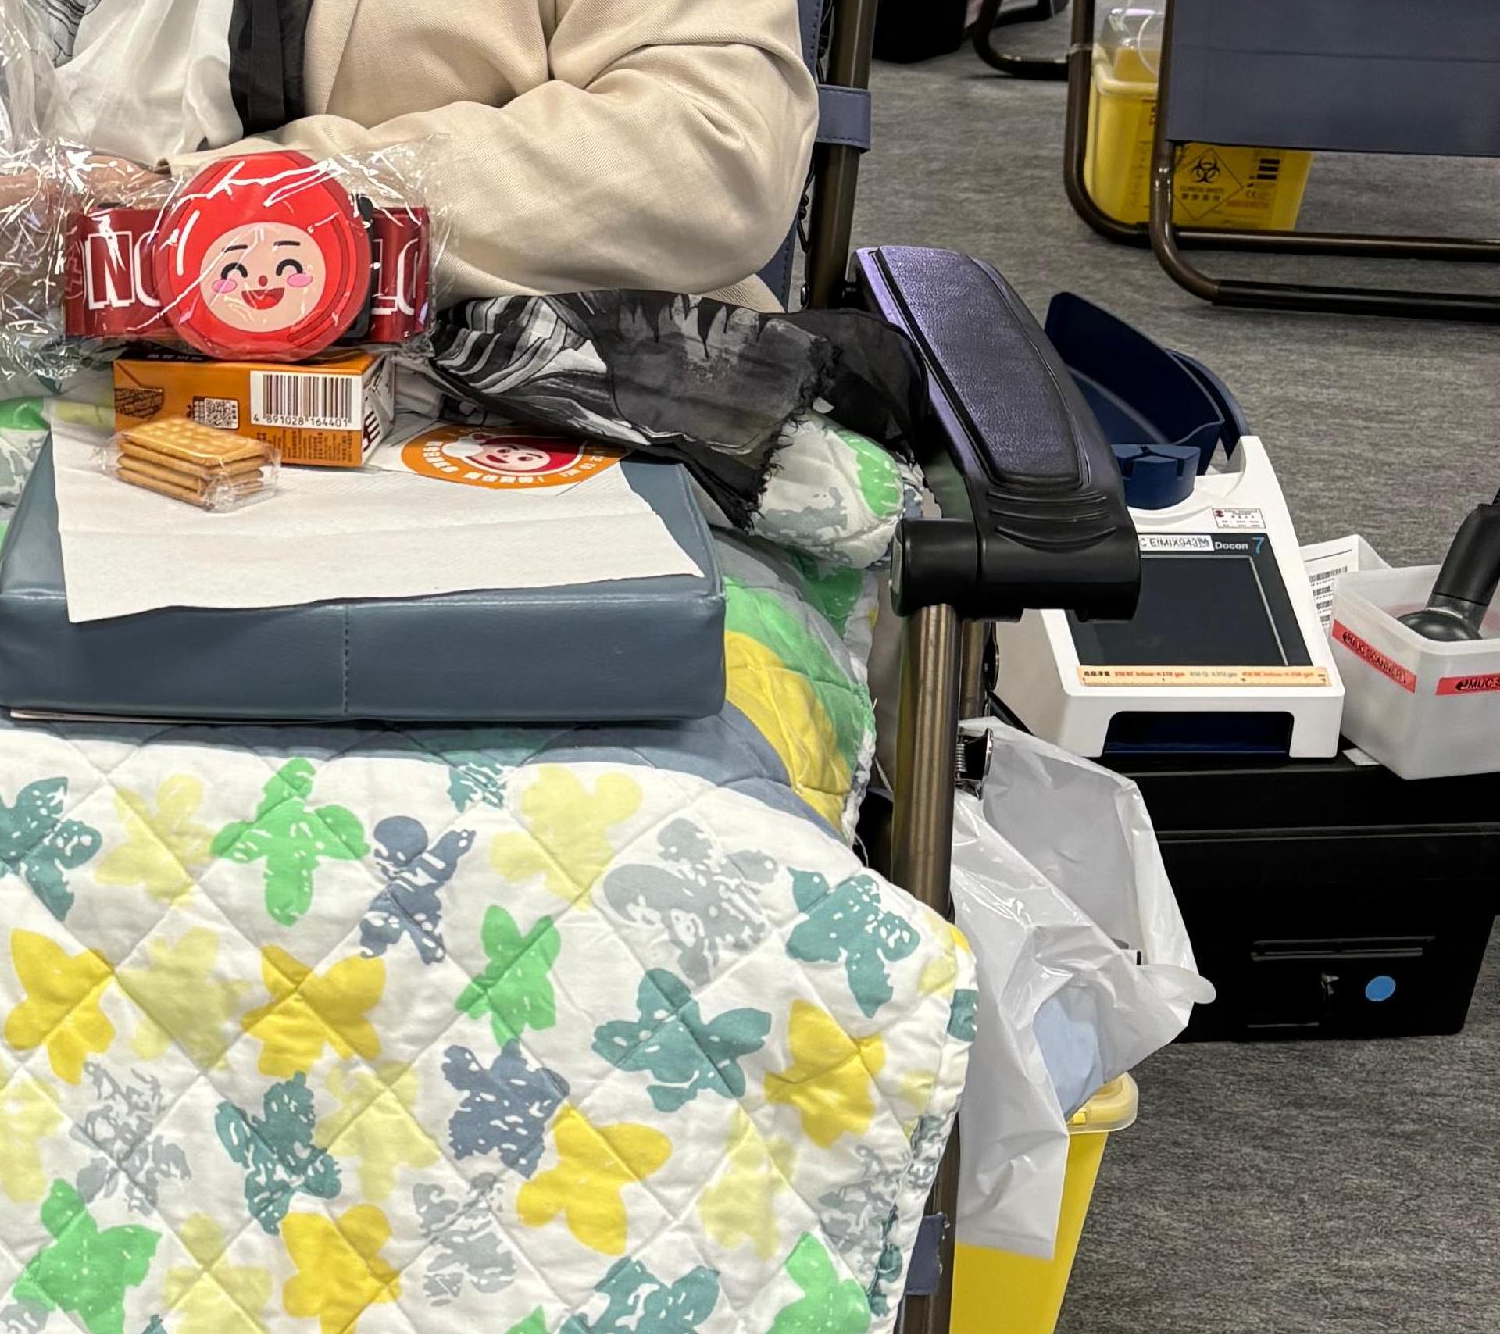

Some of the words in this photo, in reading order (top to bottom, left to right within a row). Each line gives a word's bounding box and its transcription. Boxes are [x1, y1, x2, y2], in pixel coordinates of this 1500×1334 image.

[253, 413, 260, 423] 4
[266, 414, 304, 426] 891028
[310, 417, 349, 428] 164401
[1252, 536, 1265, 555] 7
